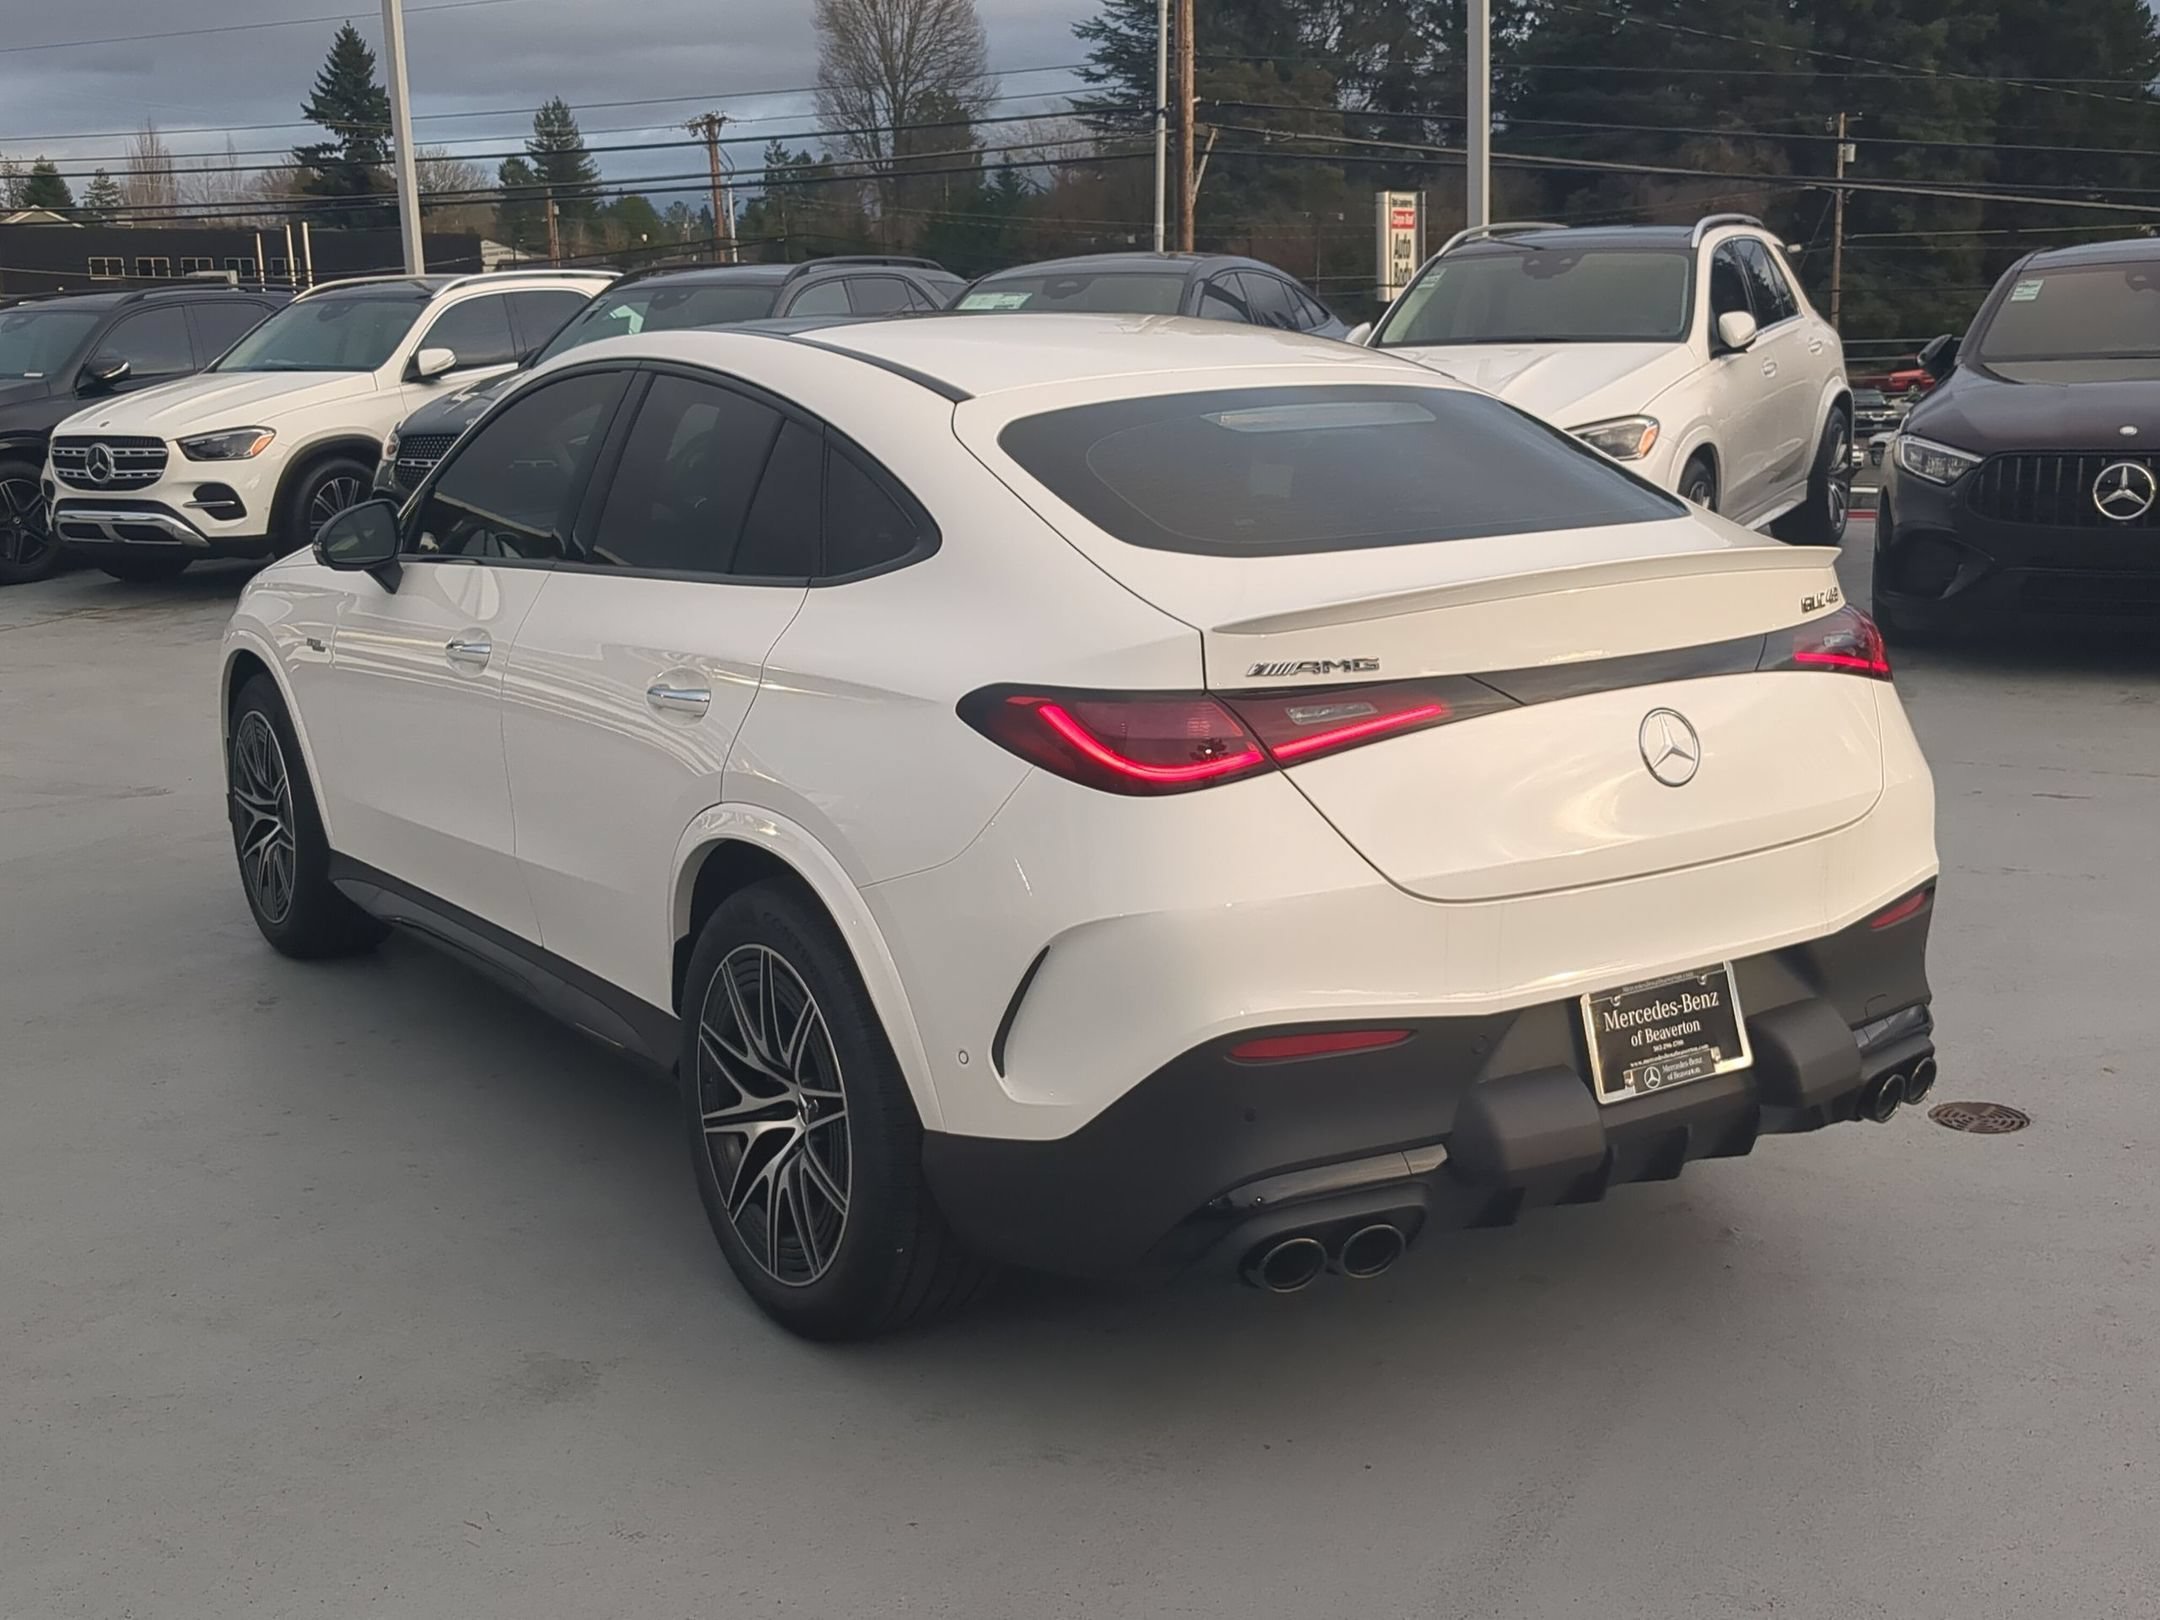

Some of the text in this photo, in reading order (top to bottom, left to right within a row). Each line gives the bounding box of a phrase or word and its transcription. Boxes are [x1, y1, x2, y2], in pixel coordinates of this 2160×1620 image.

[1393, 233, 1411, 259] Auto
[1603, 991, 1720, 1031] Mercedes-Benz
[1631, 1030, 1643, 1047] of
[1645, 1019, 1701, 1043] Beaverton
